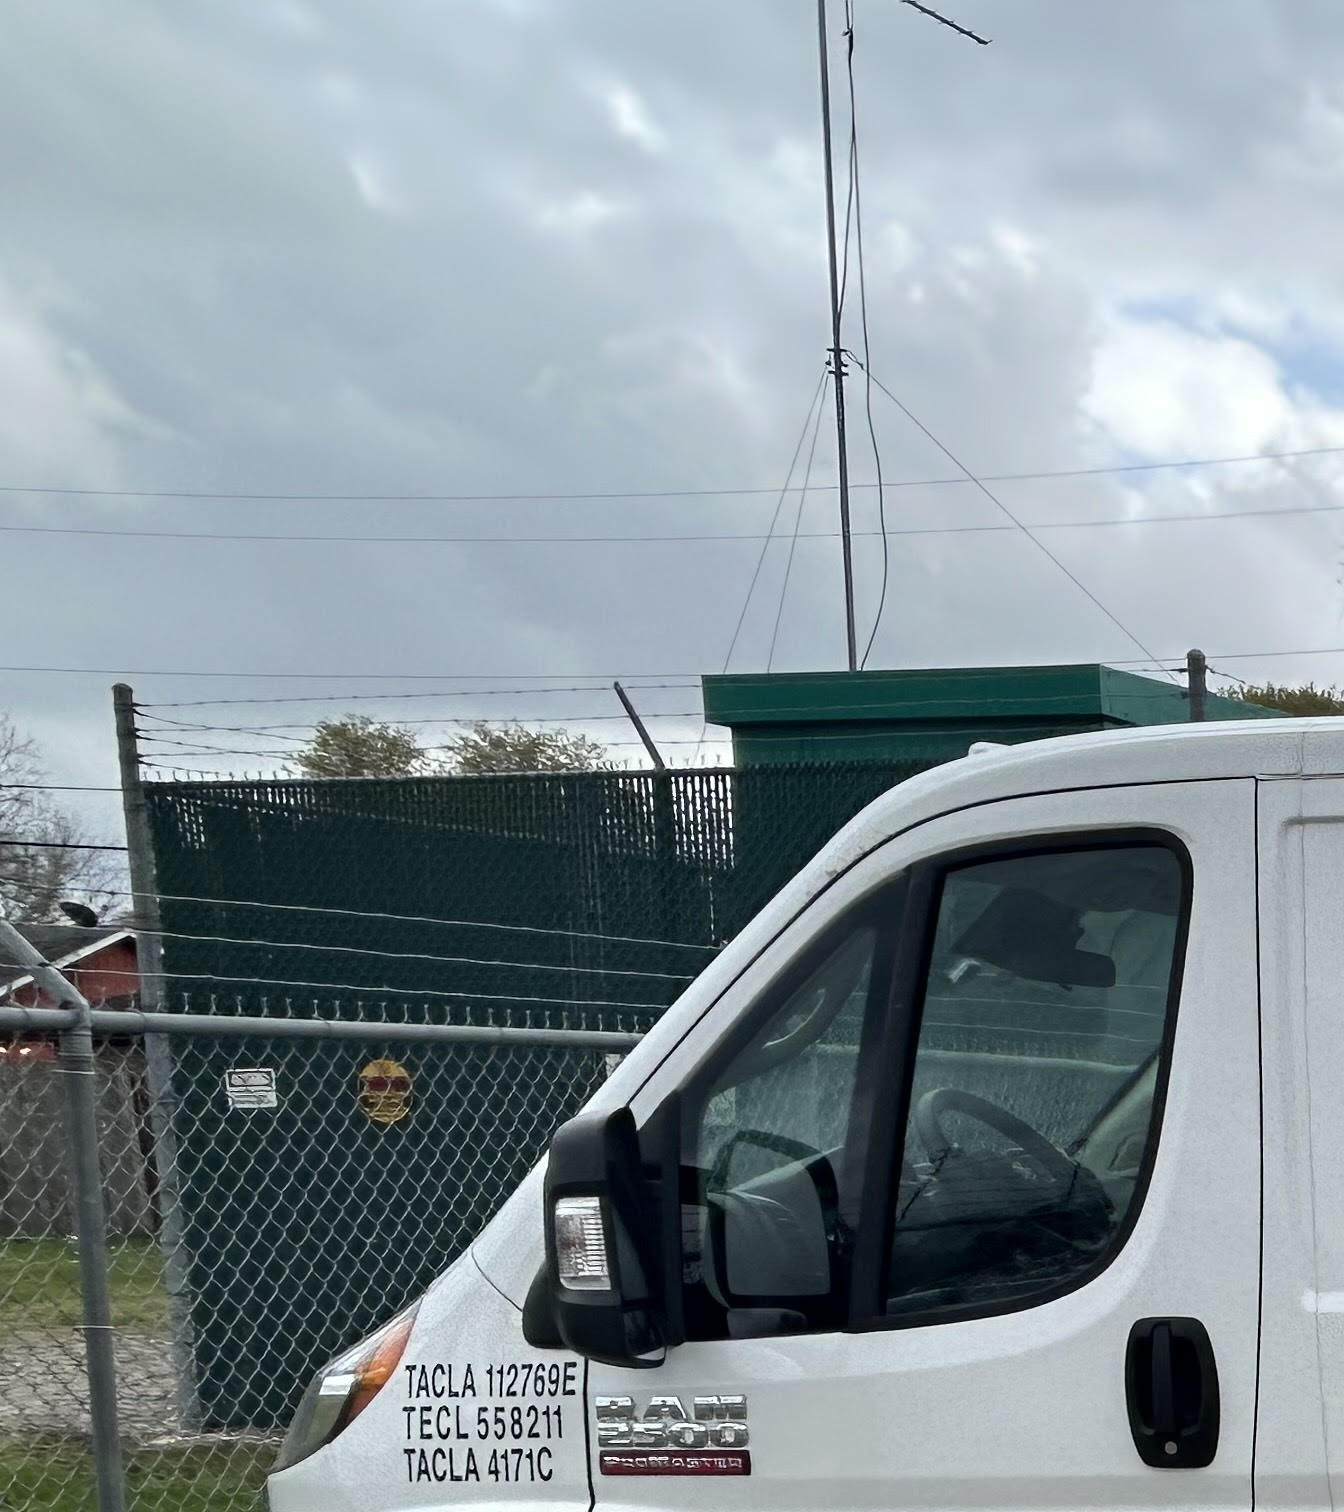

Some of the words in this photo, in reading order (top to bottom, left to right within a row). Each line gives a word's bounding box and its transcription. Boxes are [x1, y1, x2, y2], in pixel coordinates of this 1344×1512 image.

[406, 1364, 476, 1398] TACLA
[486, 1362, 577, 1398] 112769E
[402, 1405, 468, 1440] TECL
[478, 1405, 562, 1440] 558211
[404, 1448, 480, 1483] TACLA
[488, 1447, 552, 1483] 4171C
